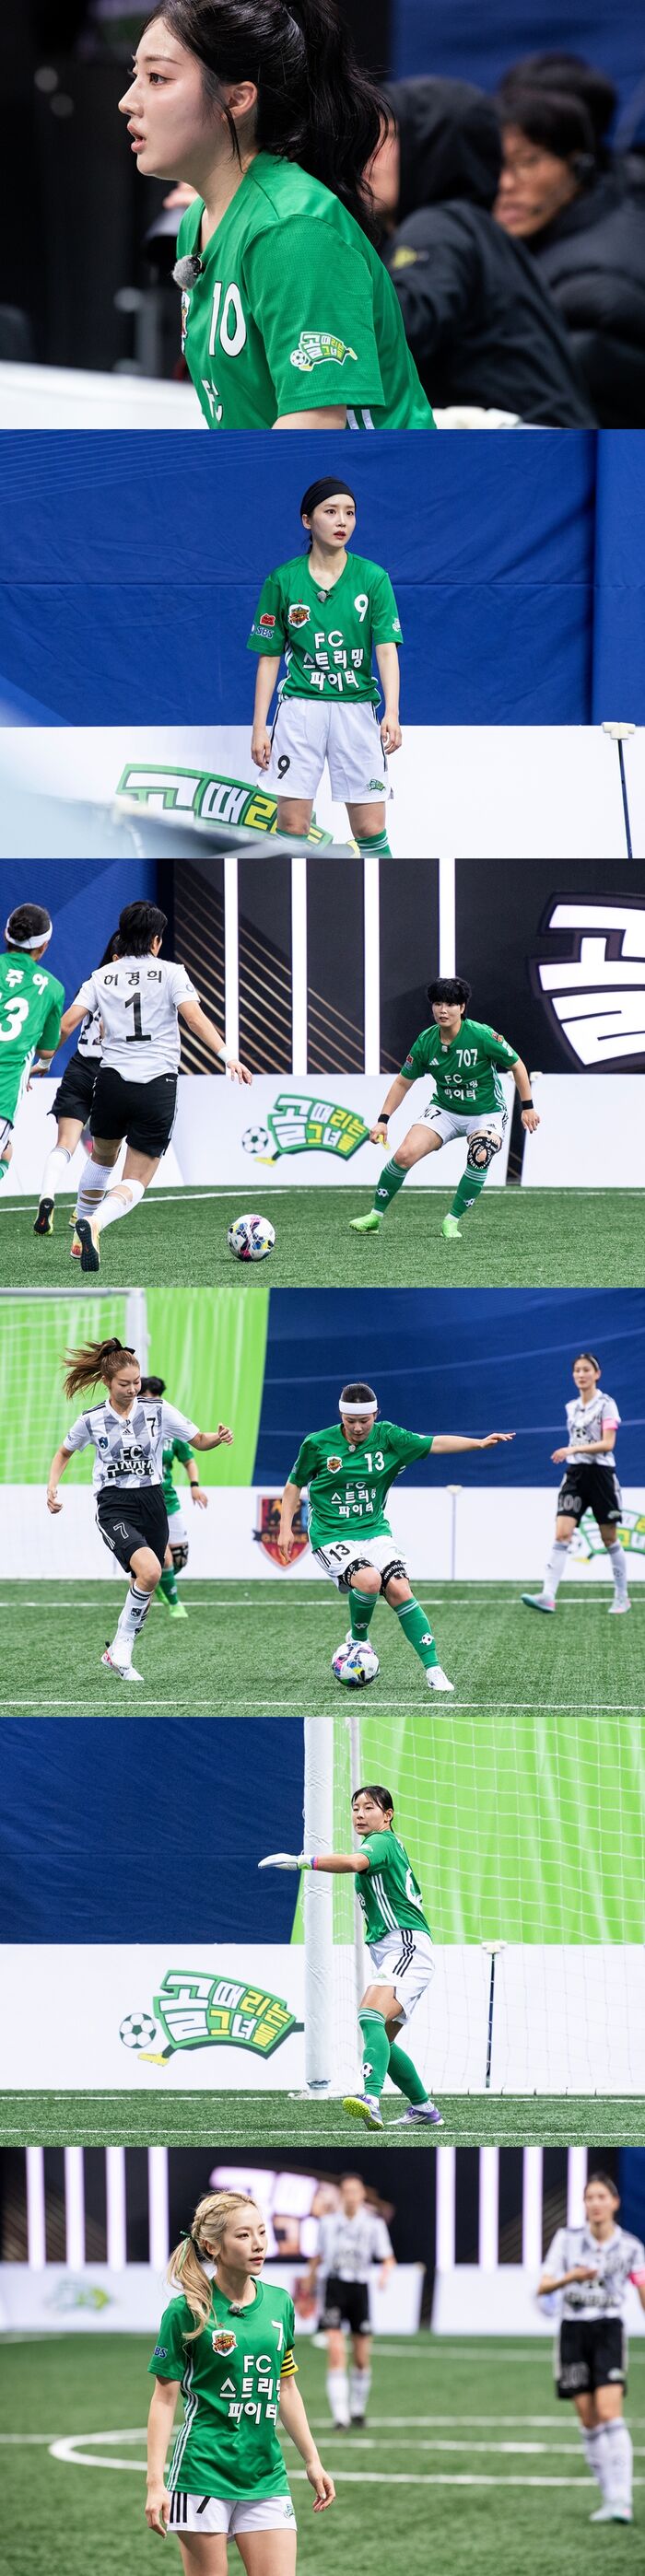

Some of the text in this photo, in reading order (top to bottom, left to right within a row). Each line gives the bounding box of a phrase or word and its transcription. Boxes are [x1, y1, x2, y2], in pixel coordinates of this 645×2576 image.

[208, 281, 247, 357] 10
[354, 594, 369, 623] 9
[256, 626, 275, 639] SBS
[314, 631, 344, 649] FC
[303, 648, 365, 670] 스트리밍
[310, 670, 360, 692] 파이터
[277, 755, 291, 779] 9
[538, 904, 645, 1066] 골
[0, 993, 29, 1042] 3
[124, 992, 152, 1042] 1
[456, 1049, 478, 1068] 707
[444, 1074, 463, 1084] FC
[272, 1098, 367, 1148] 골 때리는
[307, 1123, 358, 1153] 그녀들
[147, 1417, 157, 1438] 7
[120, 1445, 143, 1461] FC
[364, 1451, 385, 1473] 13
[338, 1500, 374, 1519] 파이터
[112, 1522, 130, 1540] 7
[329, 1544, 351, 1562] 13
[159, 1975, 291, 2042] 골 때리는
[209, 2009, 279, 2047] 그녀들
[271, 2320, 284, 2351] 7
[243, 2355, 272, 2373] FC
[228, 2402, 277, 2426] 파이터
